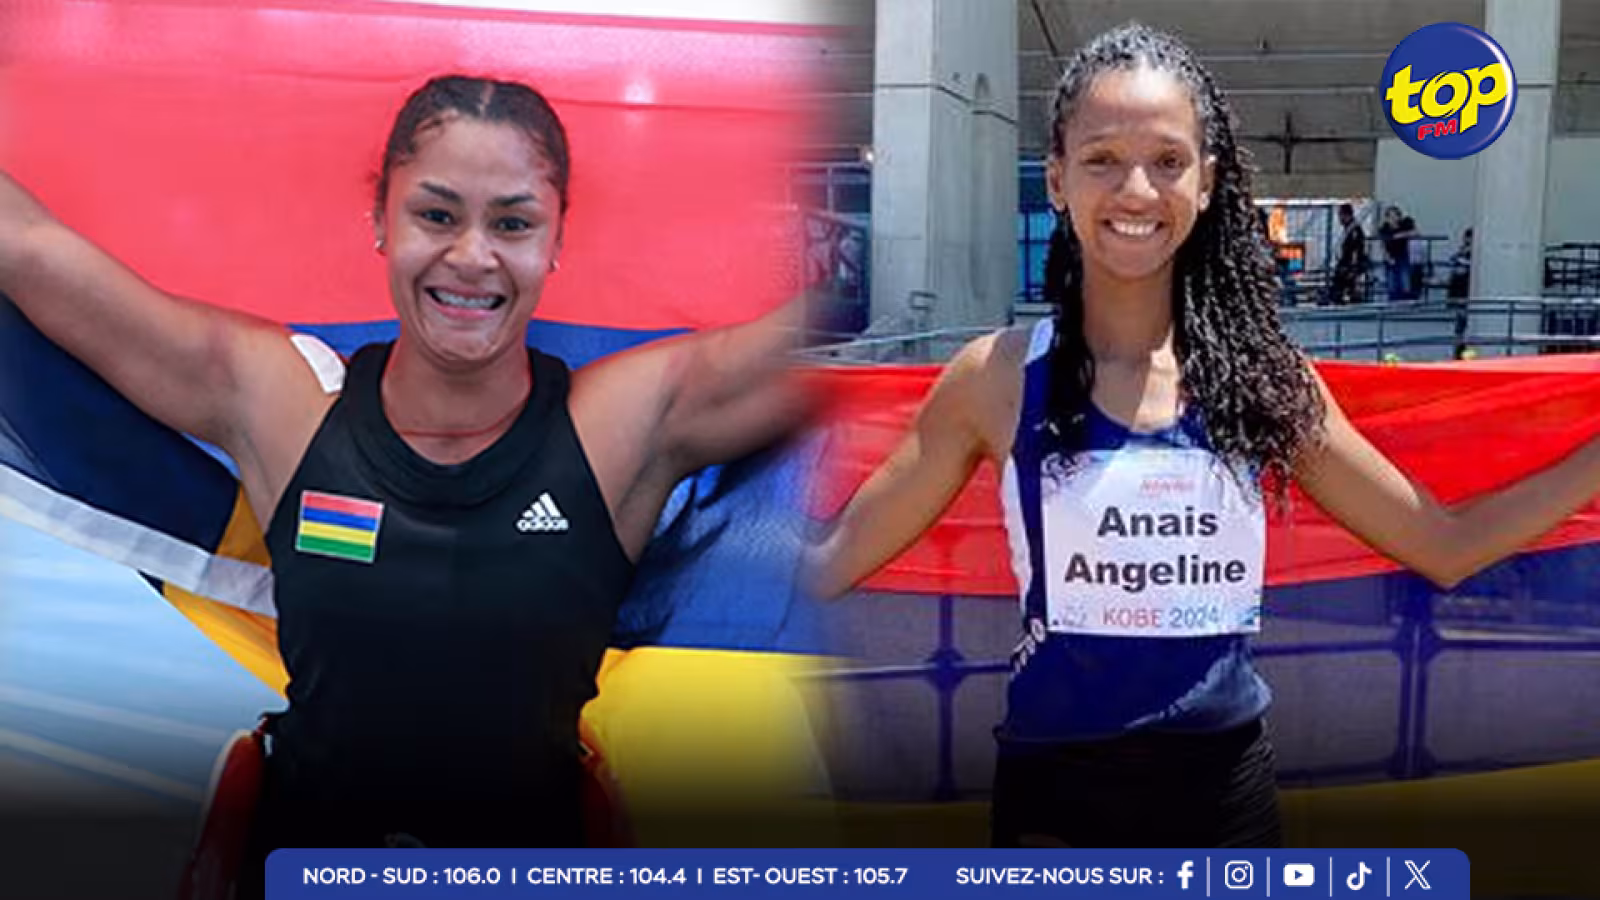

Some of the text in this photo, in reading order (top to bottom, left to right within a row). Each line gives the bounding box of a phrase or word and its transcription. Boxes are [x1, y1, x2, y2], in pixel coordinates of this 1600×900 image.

[516, 516, 569, 532] adidas
[1097, 506, 1219, 537] Anais
[1064, 553, 1246, 592] Angeline
[1103, 605, 1220, 628] KOBE 2024
